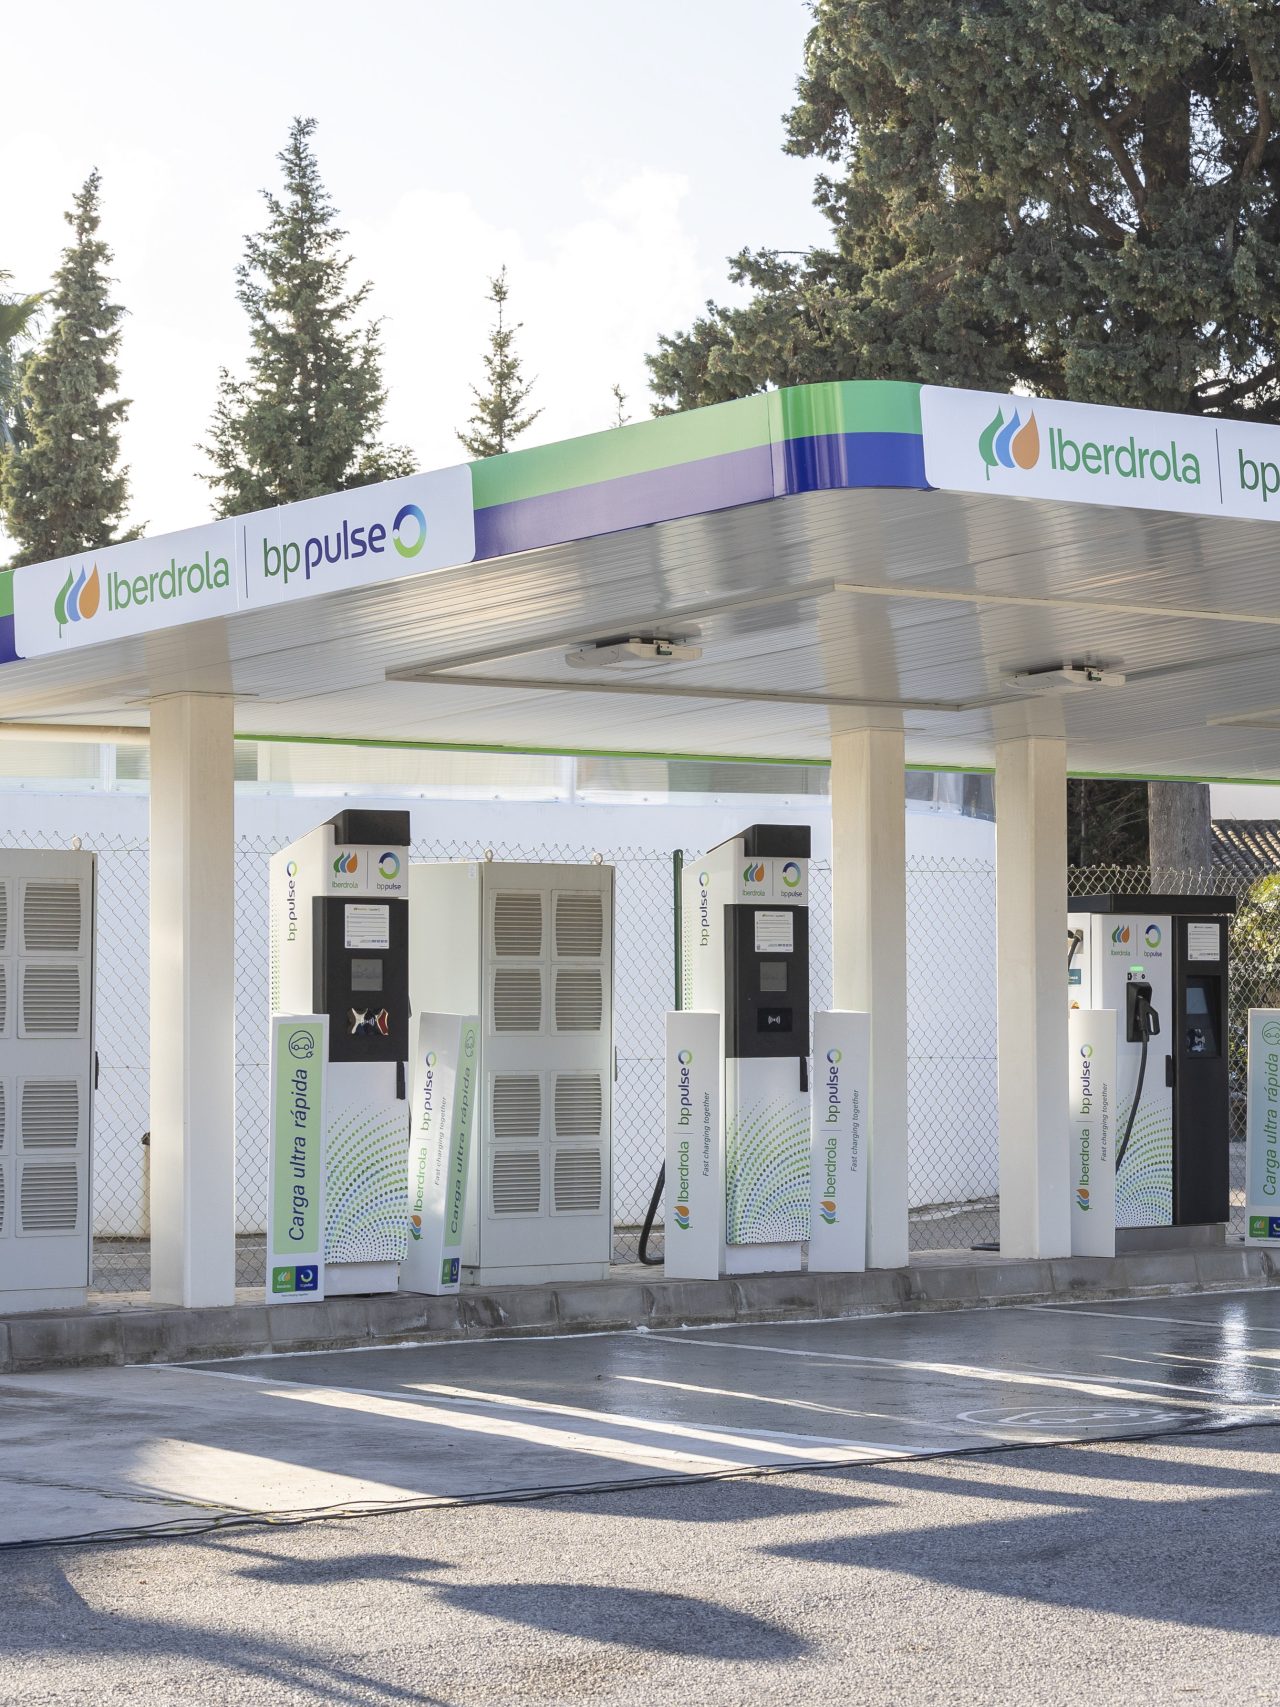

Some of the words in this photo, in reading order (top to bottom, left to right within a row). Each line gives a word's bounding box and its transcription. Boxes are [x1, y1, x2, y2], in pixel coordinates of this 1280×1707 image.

[1048, 426, 1200, 485] Iberdrola
[107, 551, 230, 611] Iberdrola
[290, 1068, 309, 1128] rápida
[461, 1067, 471, 1125] rápida
[1264, 1053, 1280, 1102] rápida
[703, 1091, 711, 1123] together
[852, 1089, 860, 1120] together
[1101, 1115, 1109, 1145] charging
[1263, 1109, 1279, 1143] ultra
[289, 1136, 307, 1178] ultra
[456, 1133, 466, 1173] ultra
[703, 1125, 712, 1158] charging
[851, 1121, 860, 1153] charging
[1079, 1128, 1090, 1186] Iberdrola
[413, 1147, 429, 1212] Iberdrola
[677, 1141, 690, 1203] Iberdrola
[702, 1159, 710, 1177] Fast
[823, 1138, 837, 1198] Iberdrola
[1262, 1145, 1280, 1197] Carga
[288, 1178, 310, 1242] Carga
[450, 1180, 463, 1234] Carga
